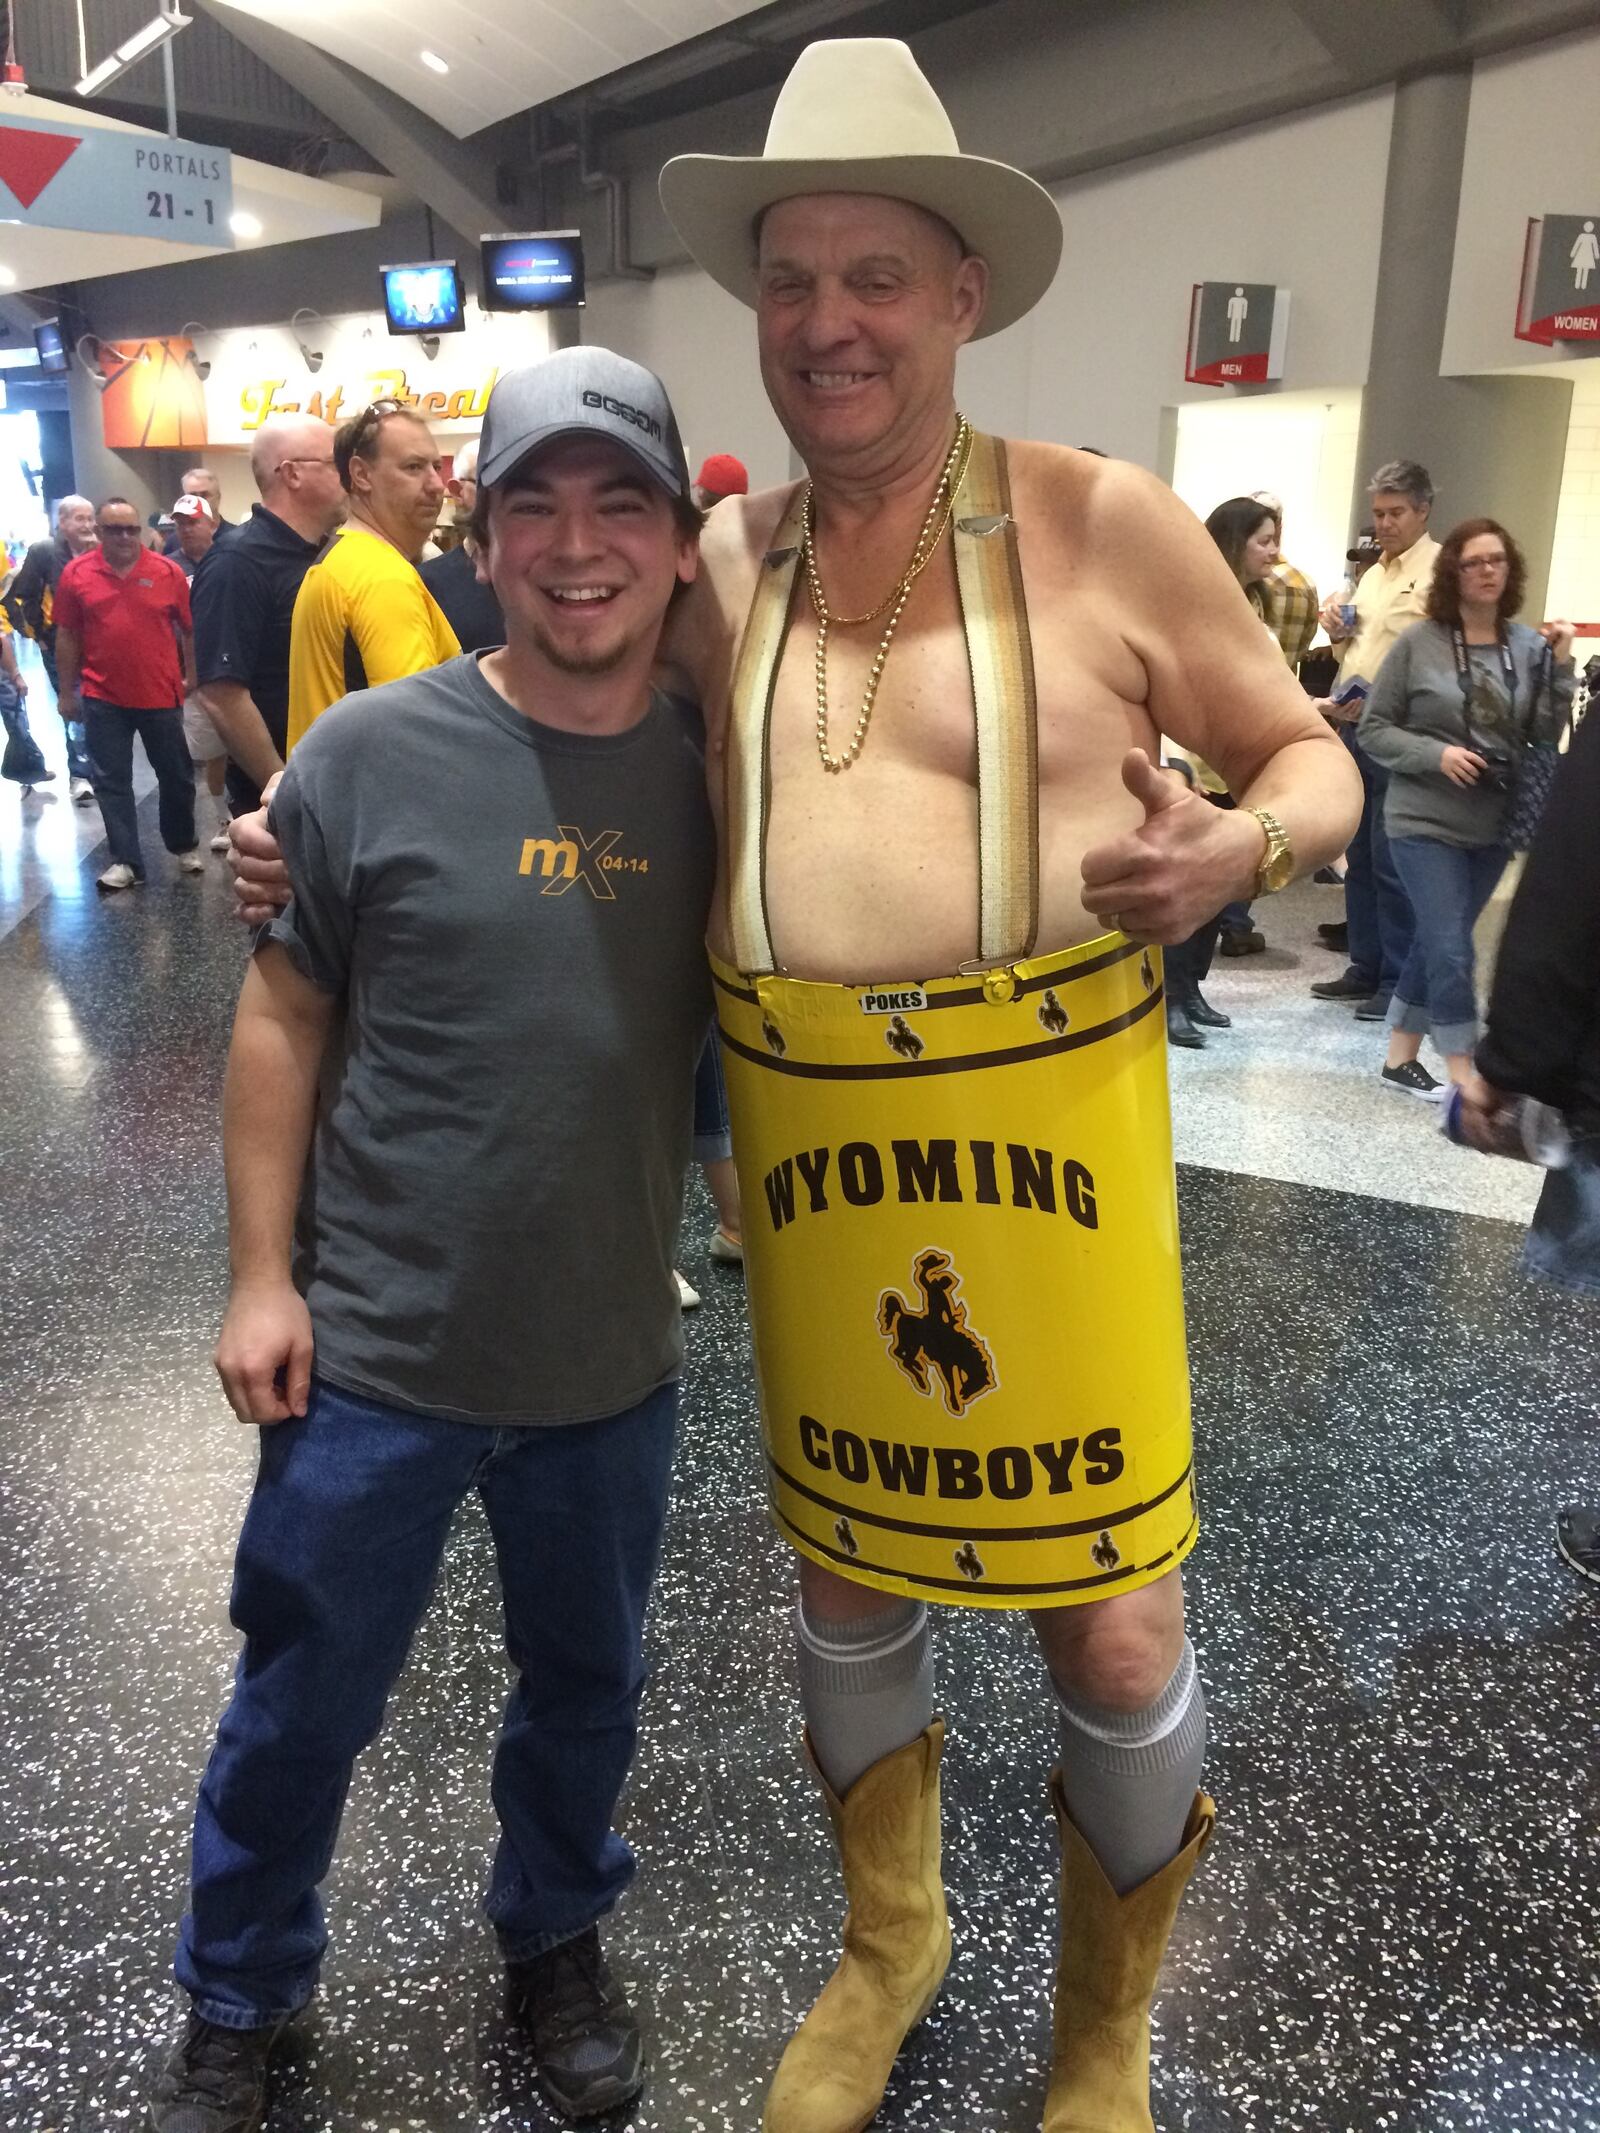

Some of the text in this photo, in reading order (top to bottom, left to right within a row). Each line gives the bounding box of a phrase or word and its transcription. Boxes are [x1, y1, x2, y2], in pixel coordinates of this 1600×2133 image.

[135, 148, 221, 181] PORTALS
[146, 190, 175, 220] 21
[1554, 315, 1598, 331] WOMEN
[1221, 363, 1242, 376] MEN
[864, 990, 923, 1011] POKES
[764, 1138, 1099, 1233] WYOMING
[798, 1414, 1125, 1501] COWBOYS
